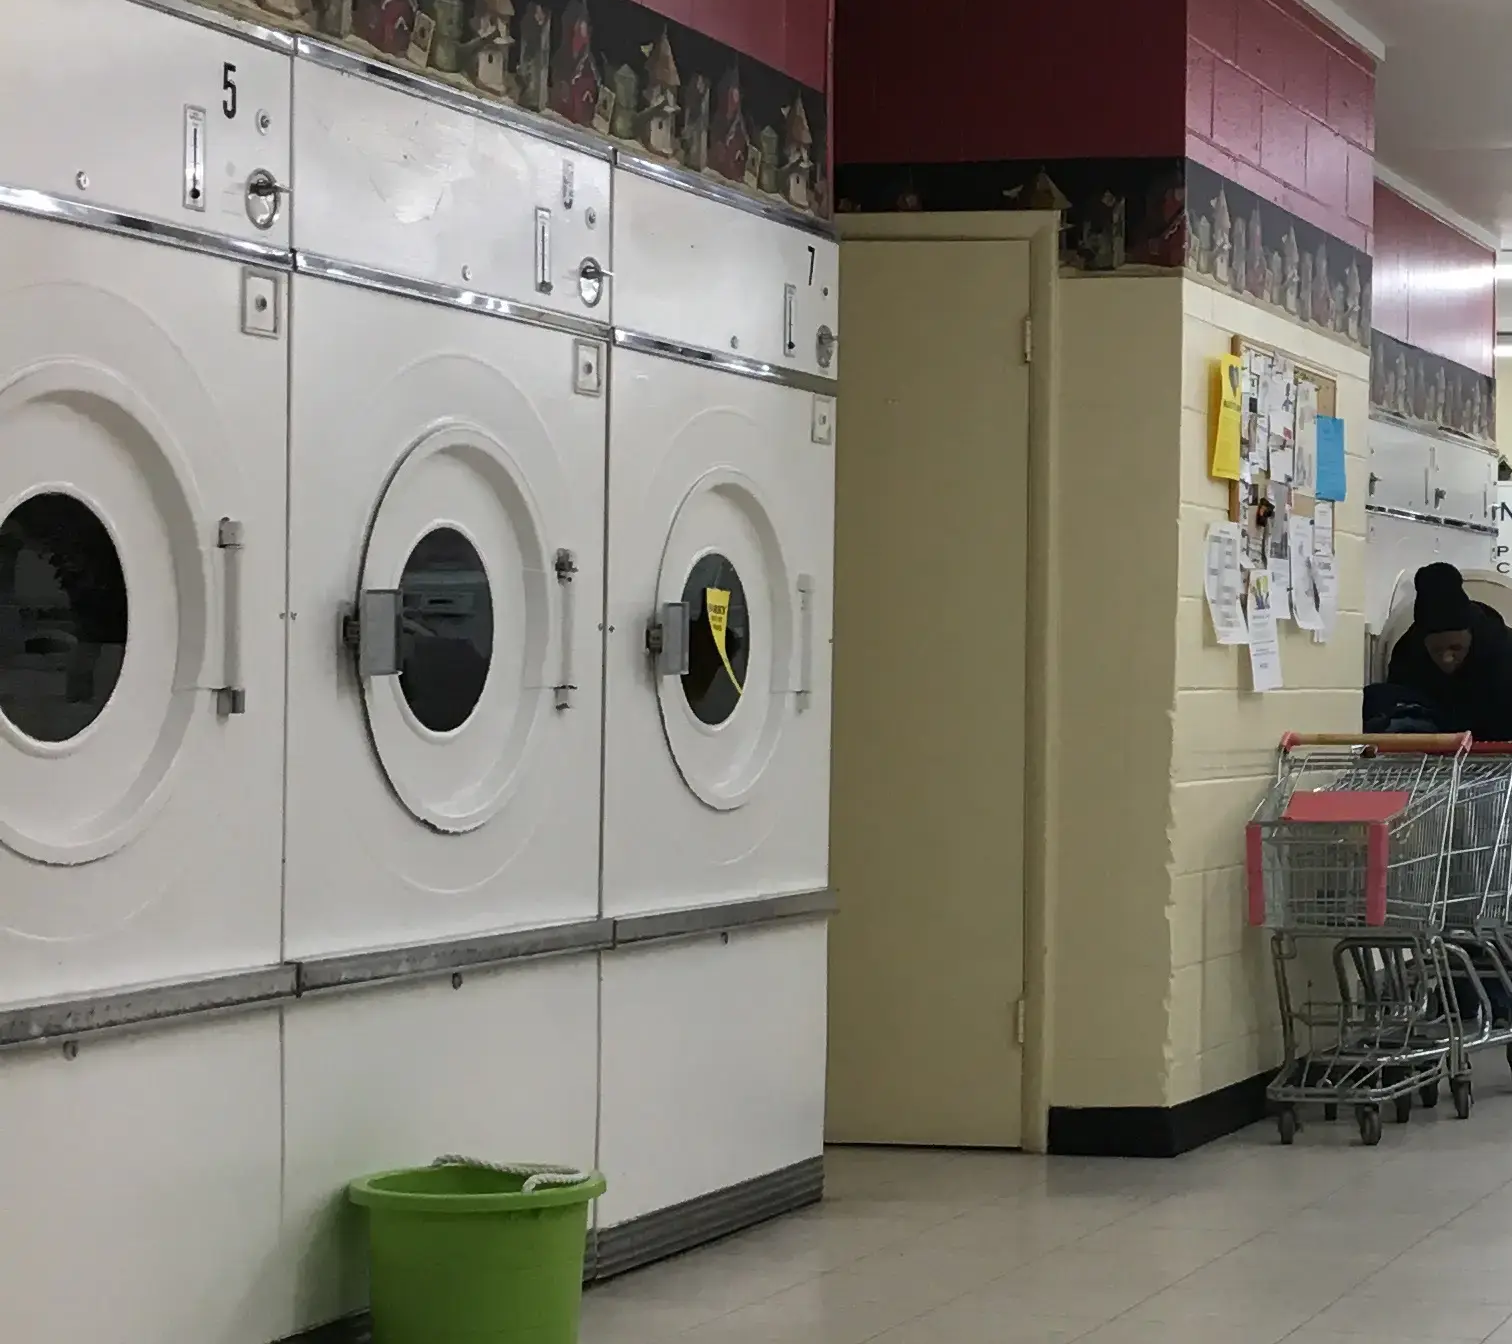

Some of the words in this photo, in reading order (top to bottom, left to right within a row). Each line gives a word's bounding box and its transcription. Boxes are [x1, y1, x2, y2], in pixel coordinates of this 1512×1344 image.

[222, 61, 237, 119] 5
[807, 245, 816, 286] 7
[1496, 545, 1510, 557] P
